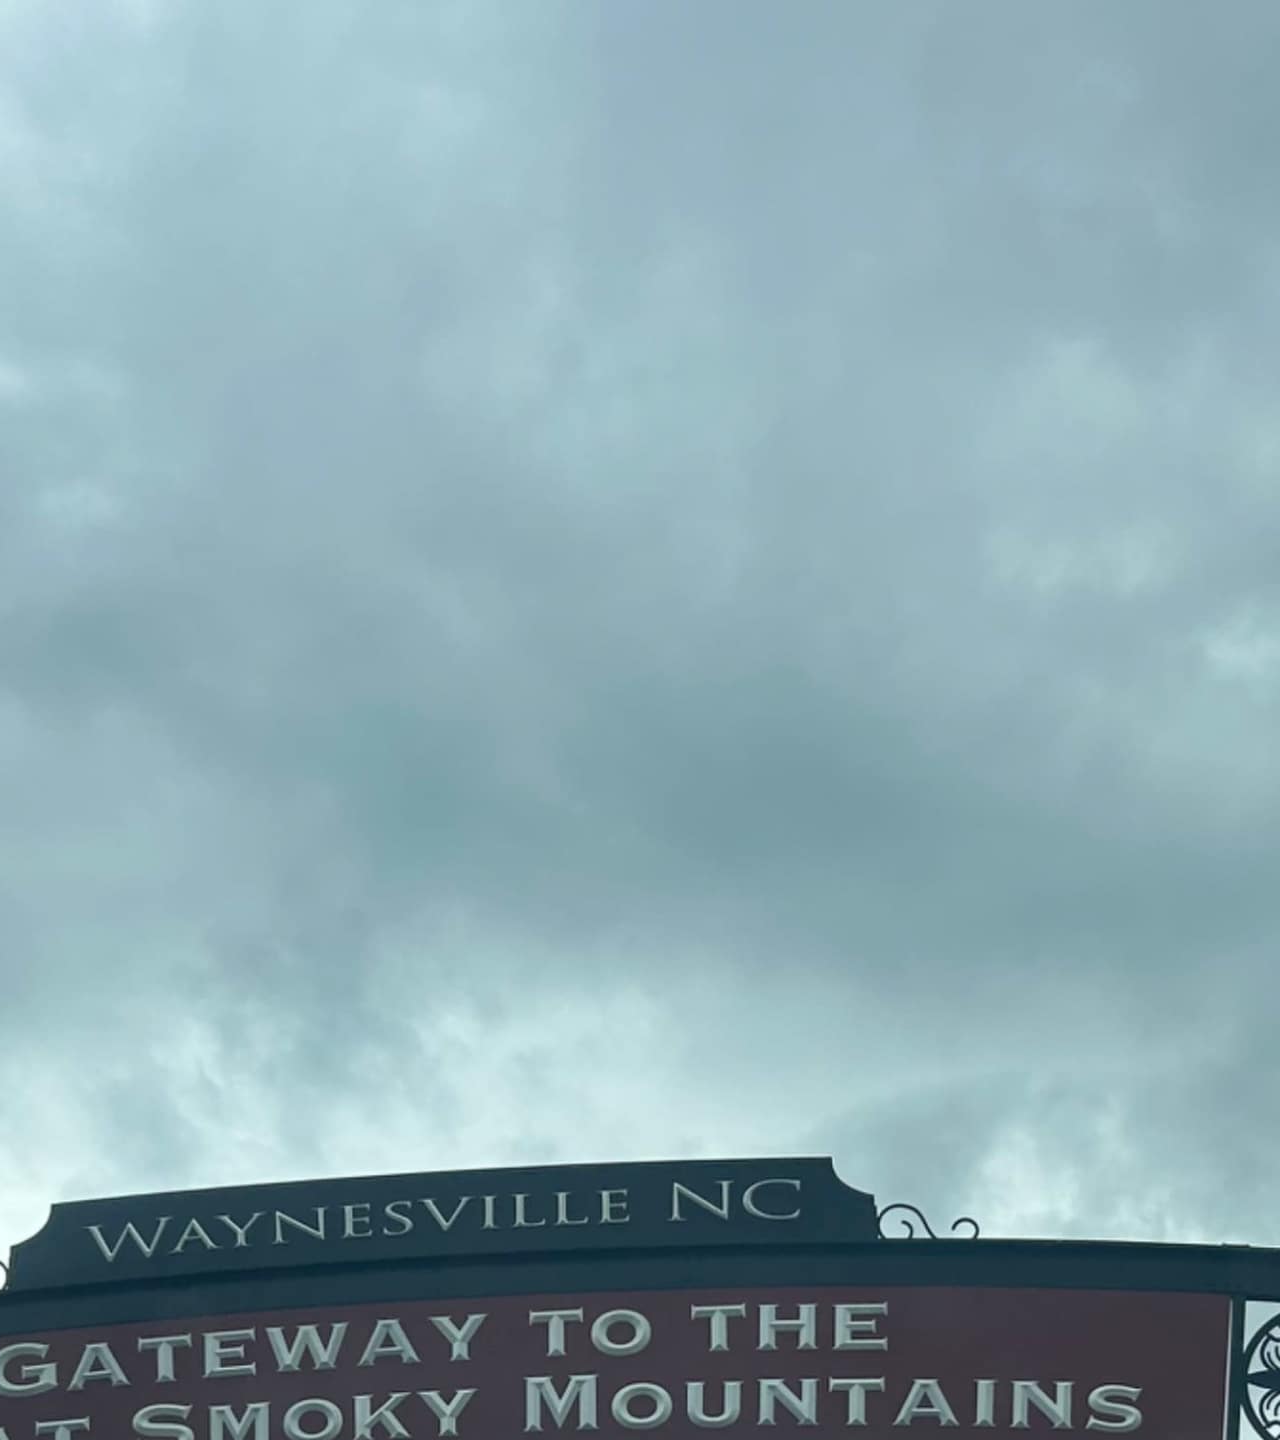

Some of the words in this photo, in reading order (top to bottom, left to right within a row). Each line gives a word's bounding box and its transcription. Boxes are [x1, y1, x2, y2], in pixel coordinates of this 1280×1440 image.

[88, 1188, 631, 1262] WAYNESVILLE
[667, 1178, 802, 1223] NC
[528, 1306, 652, 1358] TO
[690, 1301, 889, 1352] THE
[522, 1373, 1143, 1434] MOUNTAINS
